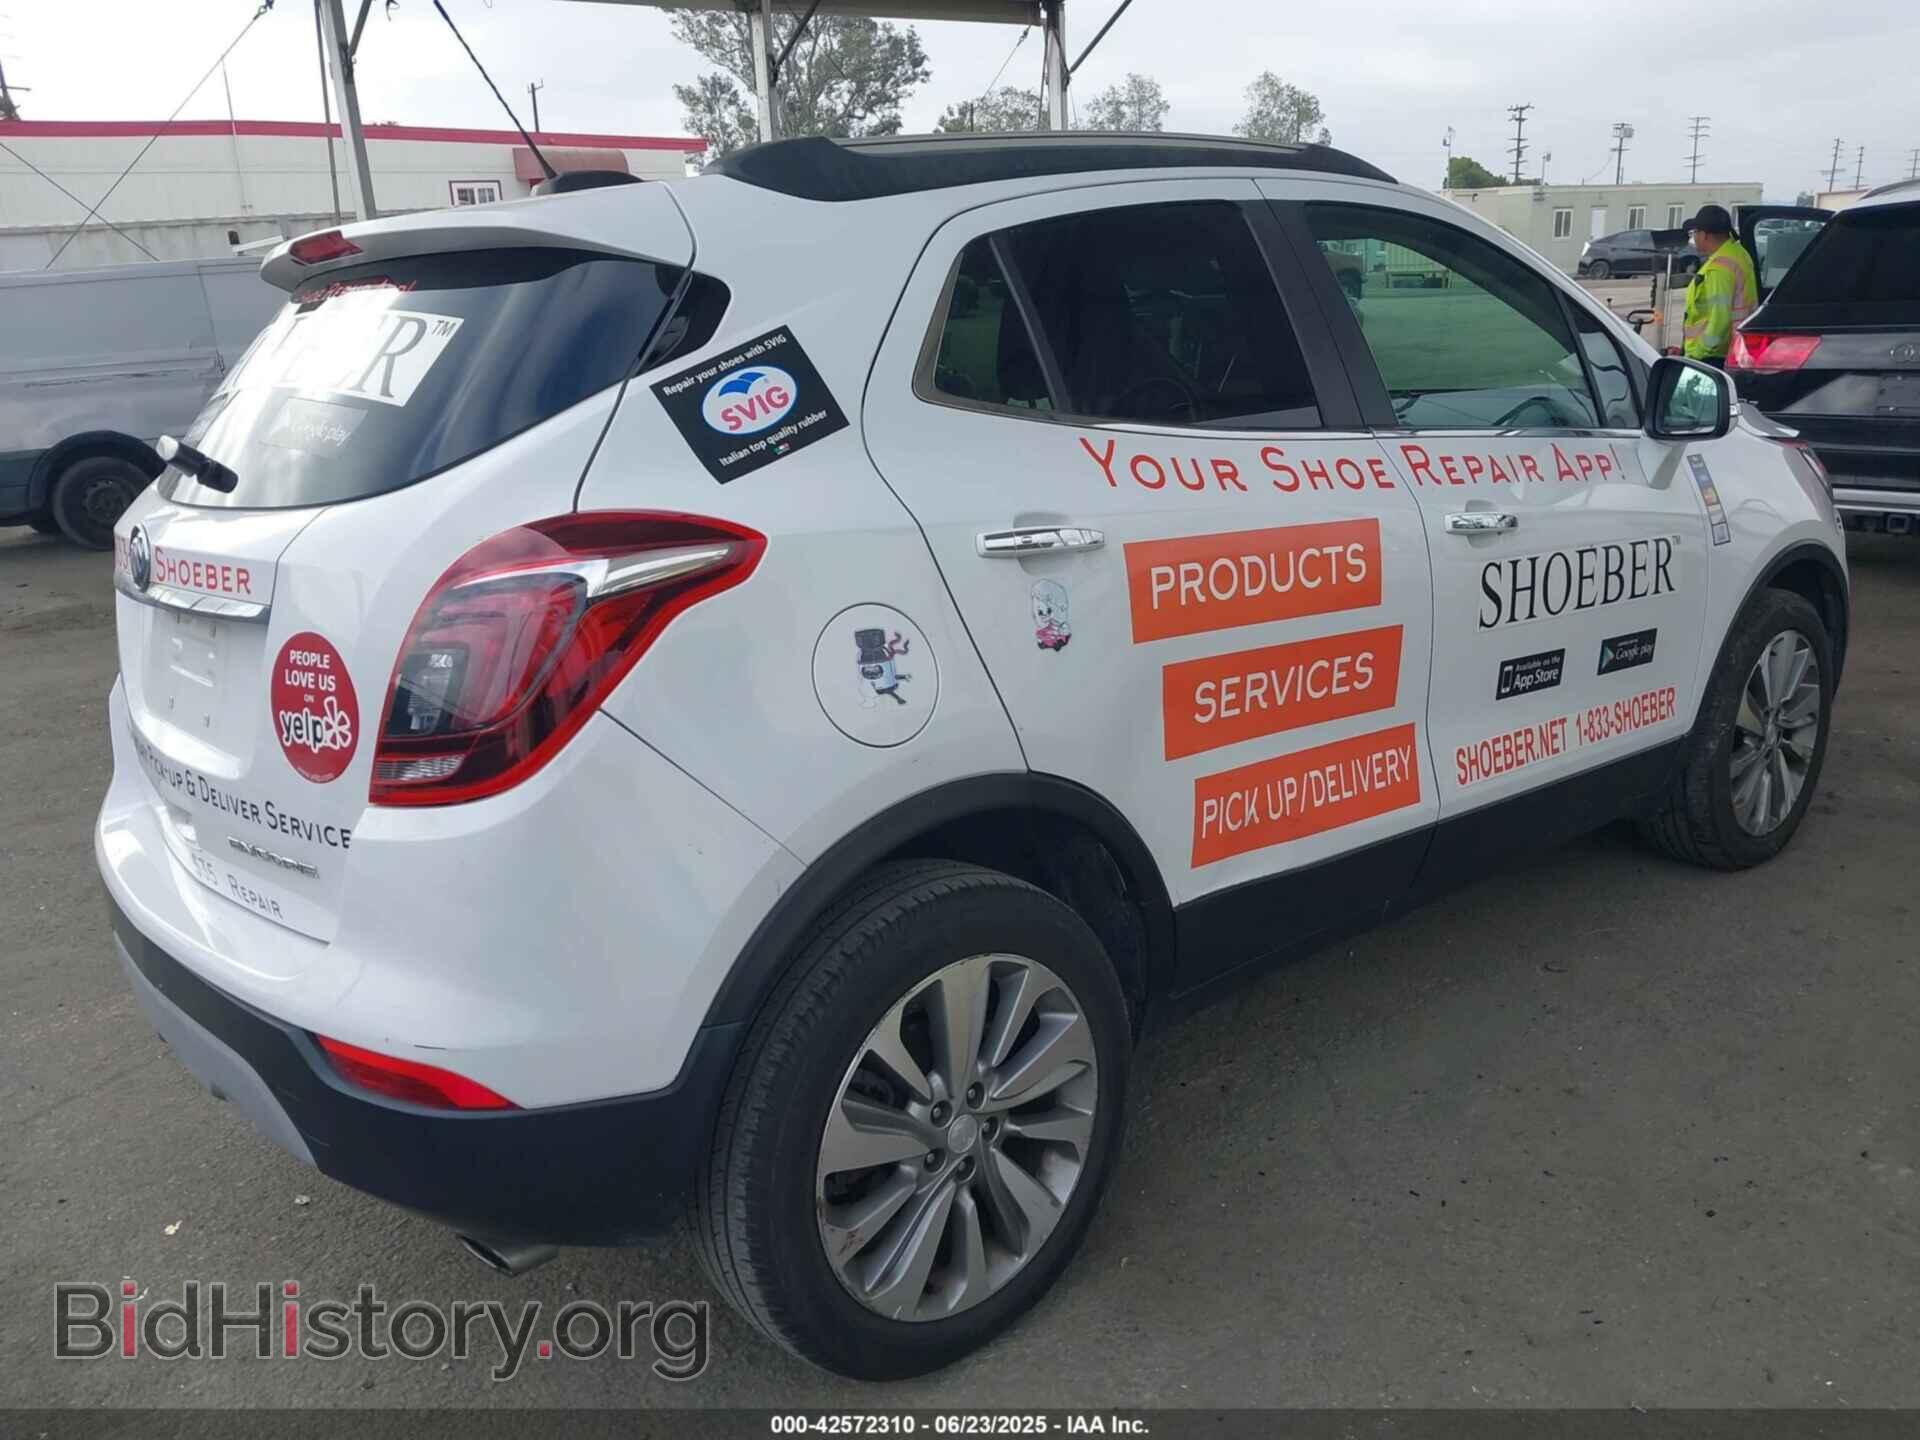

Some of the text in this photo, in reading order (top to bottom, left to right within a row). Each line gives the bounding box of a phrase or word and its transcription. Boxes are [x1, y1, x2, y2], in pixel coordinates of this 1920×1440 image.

[662, 333, 787, 396] Repair your shoes with SVIG
[720, 385, 789, 431] SVIG
[719, 409, 828, 467] Italian top quality rubber
[1079, 437, 1626, 493] YOUR SHOE REPAIR APP!
[154, 545, 252, 595] SHOEBER
[1150, 542, 1368, 610] PRODUCTS
[1478, 537, 1676, 630] SHOEBER
[284, 668, 336, 692] LOVE US
[289, 649, 331, 669] PEOPLE
[1513, 668, 1559, 690] App Store
[1515, 659, 1542, 672] Available
[1193, 651, 1374, 724] SERVICES
[280, 708, 325, 753] yelp
[1456, 687, 1676, 786] SHOEBER.NET 1-833-SHOEBER
[198, 775, 262, 825] DELIVER
[265, 801, 351, 849] SERVICE
[1201, 744, 1412, 840] PICK UP/DELIVERY
[227, 873, 283, 920] REPAIR
